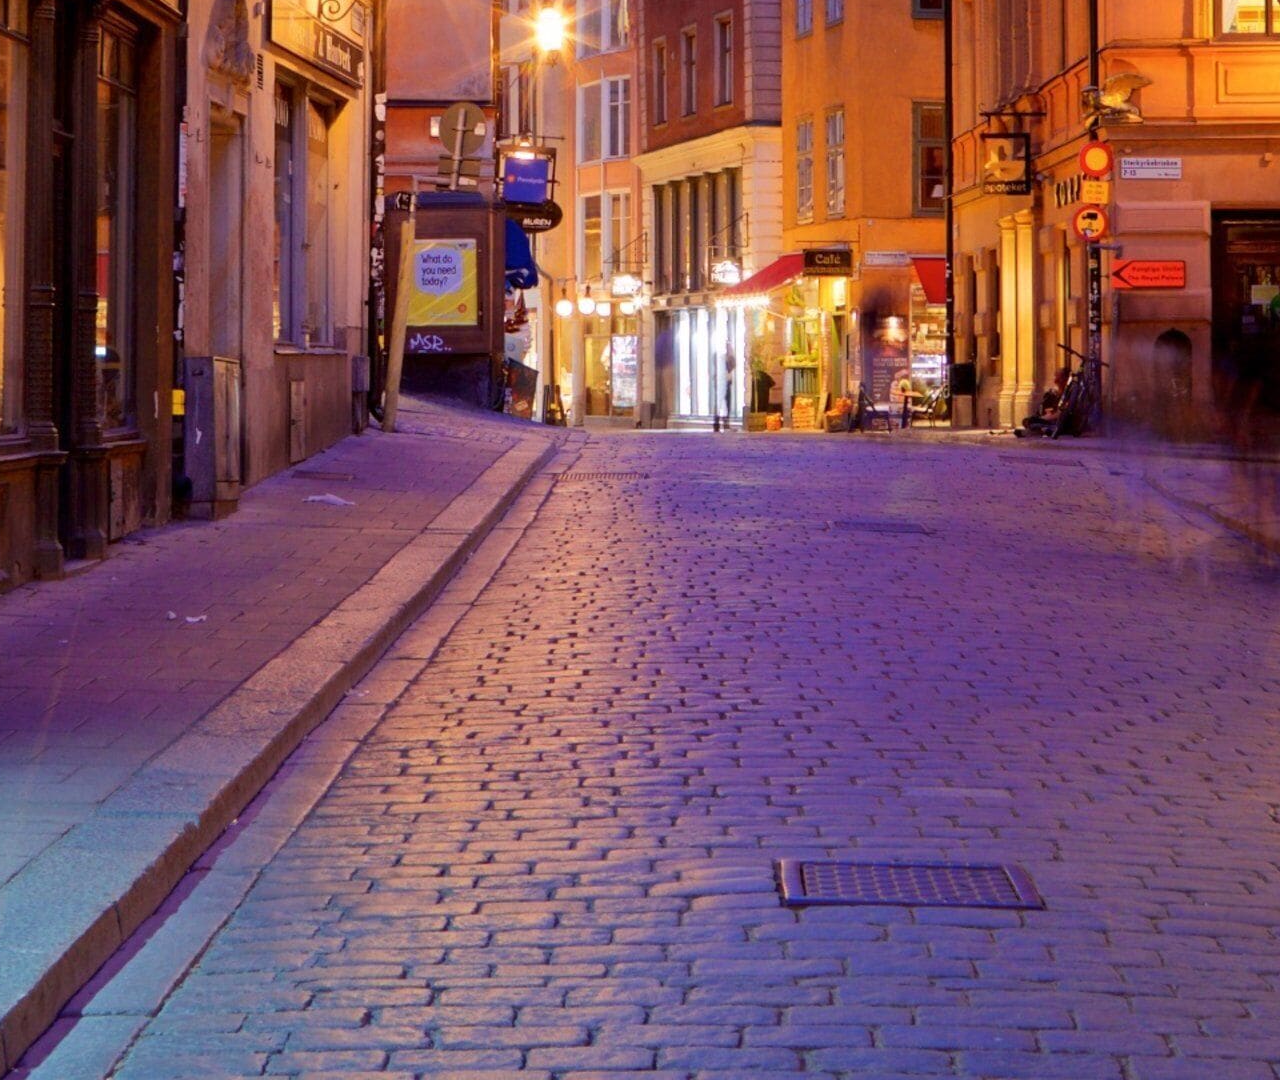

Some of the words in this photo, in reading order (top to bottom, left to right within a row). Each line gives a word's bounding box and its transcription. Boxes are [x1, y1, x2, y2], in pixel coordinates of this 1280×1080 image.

[983, 182, 1027, 194] apoteket
[422, 254, 441, 264] What
[442, 254, 453, 264] do
[815, 253, 841, 265] Café
[422, 266, 435, 276] you
[437, 265, 457, 275] need
[422, 276, 448, 289] today?
